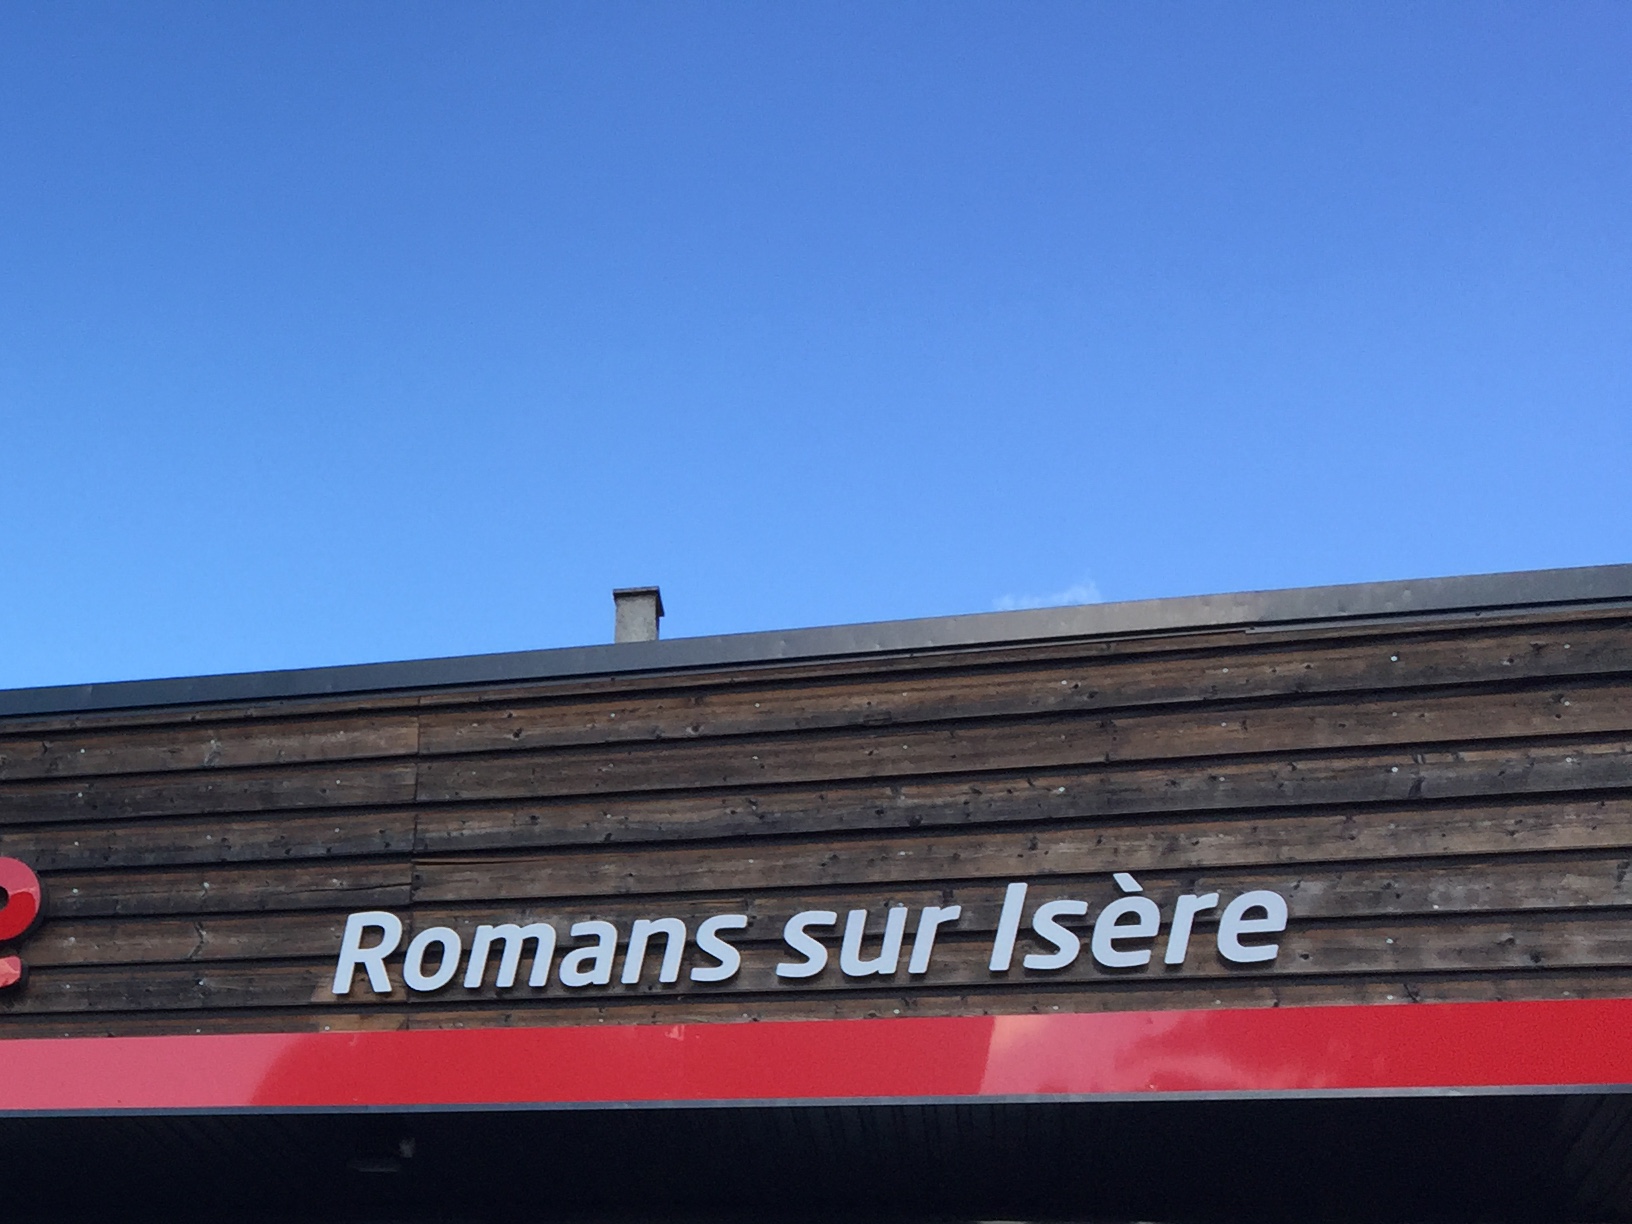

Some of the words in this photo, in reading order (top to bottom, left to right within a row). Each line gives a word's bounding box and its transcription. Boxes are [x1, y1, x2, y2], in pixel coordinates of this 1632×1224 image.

[331, 909, 748, 996] Romans
[775, 904, 961, 981] sur
[987, 872, 1289, 973] Isère
